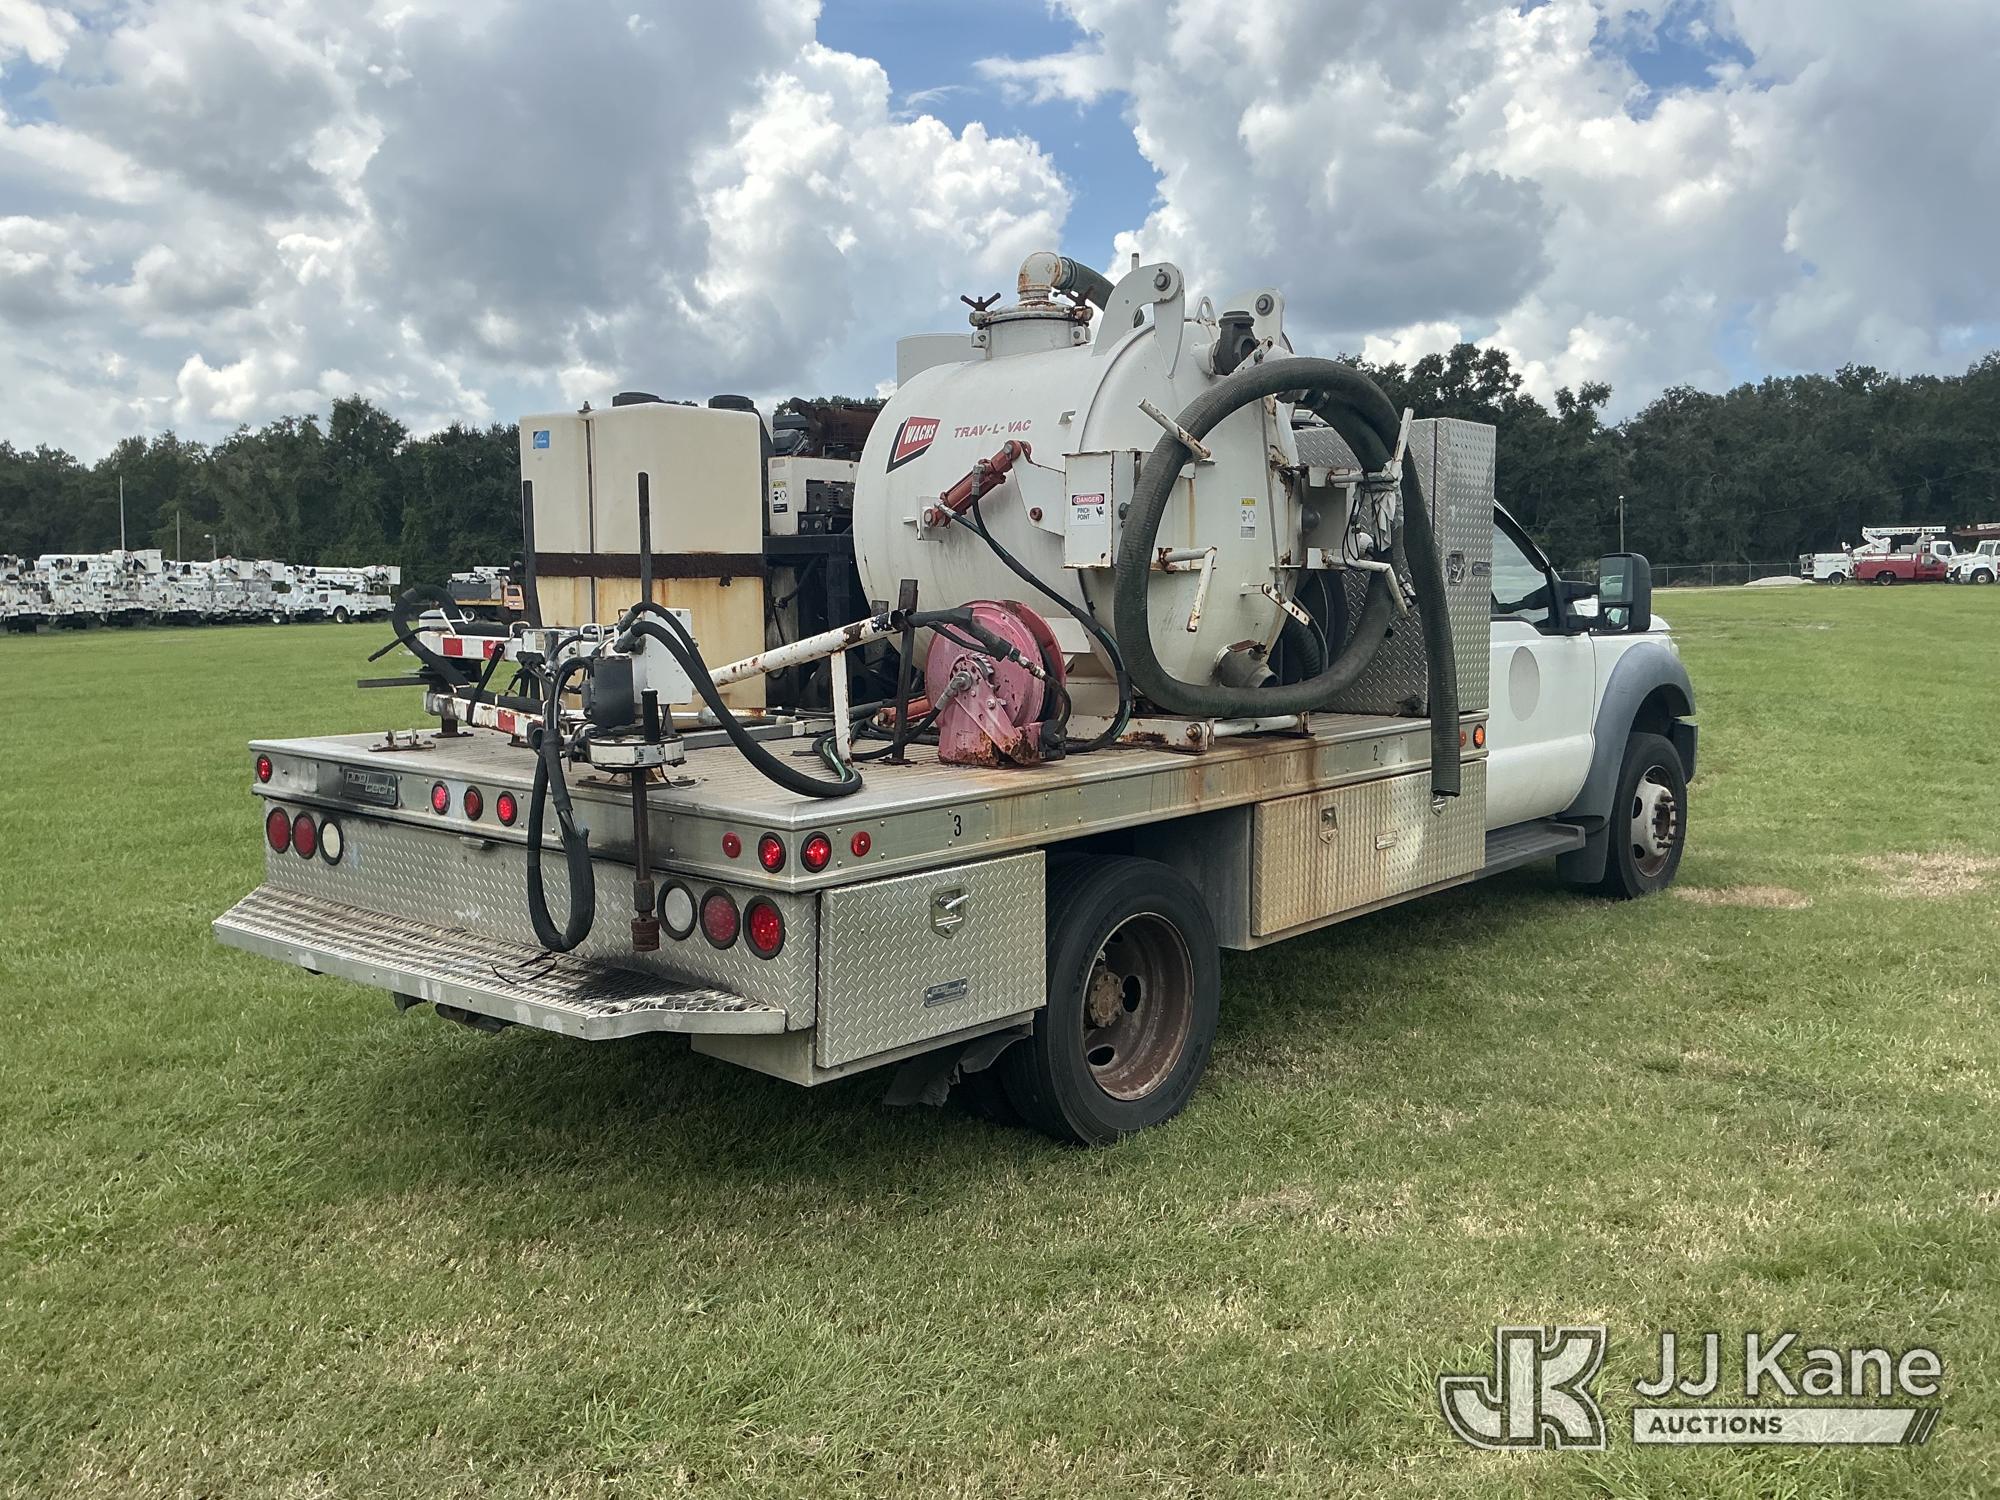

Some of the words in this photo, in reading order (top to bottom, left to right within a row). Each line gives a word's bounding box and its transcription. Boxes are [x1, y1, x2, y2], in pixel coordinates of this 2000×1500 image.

[904, 424, 935, 444] WACHS
[1373, 744, 1378, 761] 2
[953, 814, 962, 837] 3
